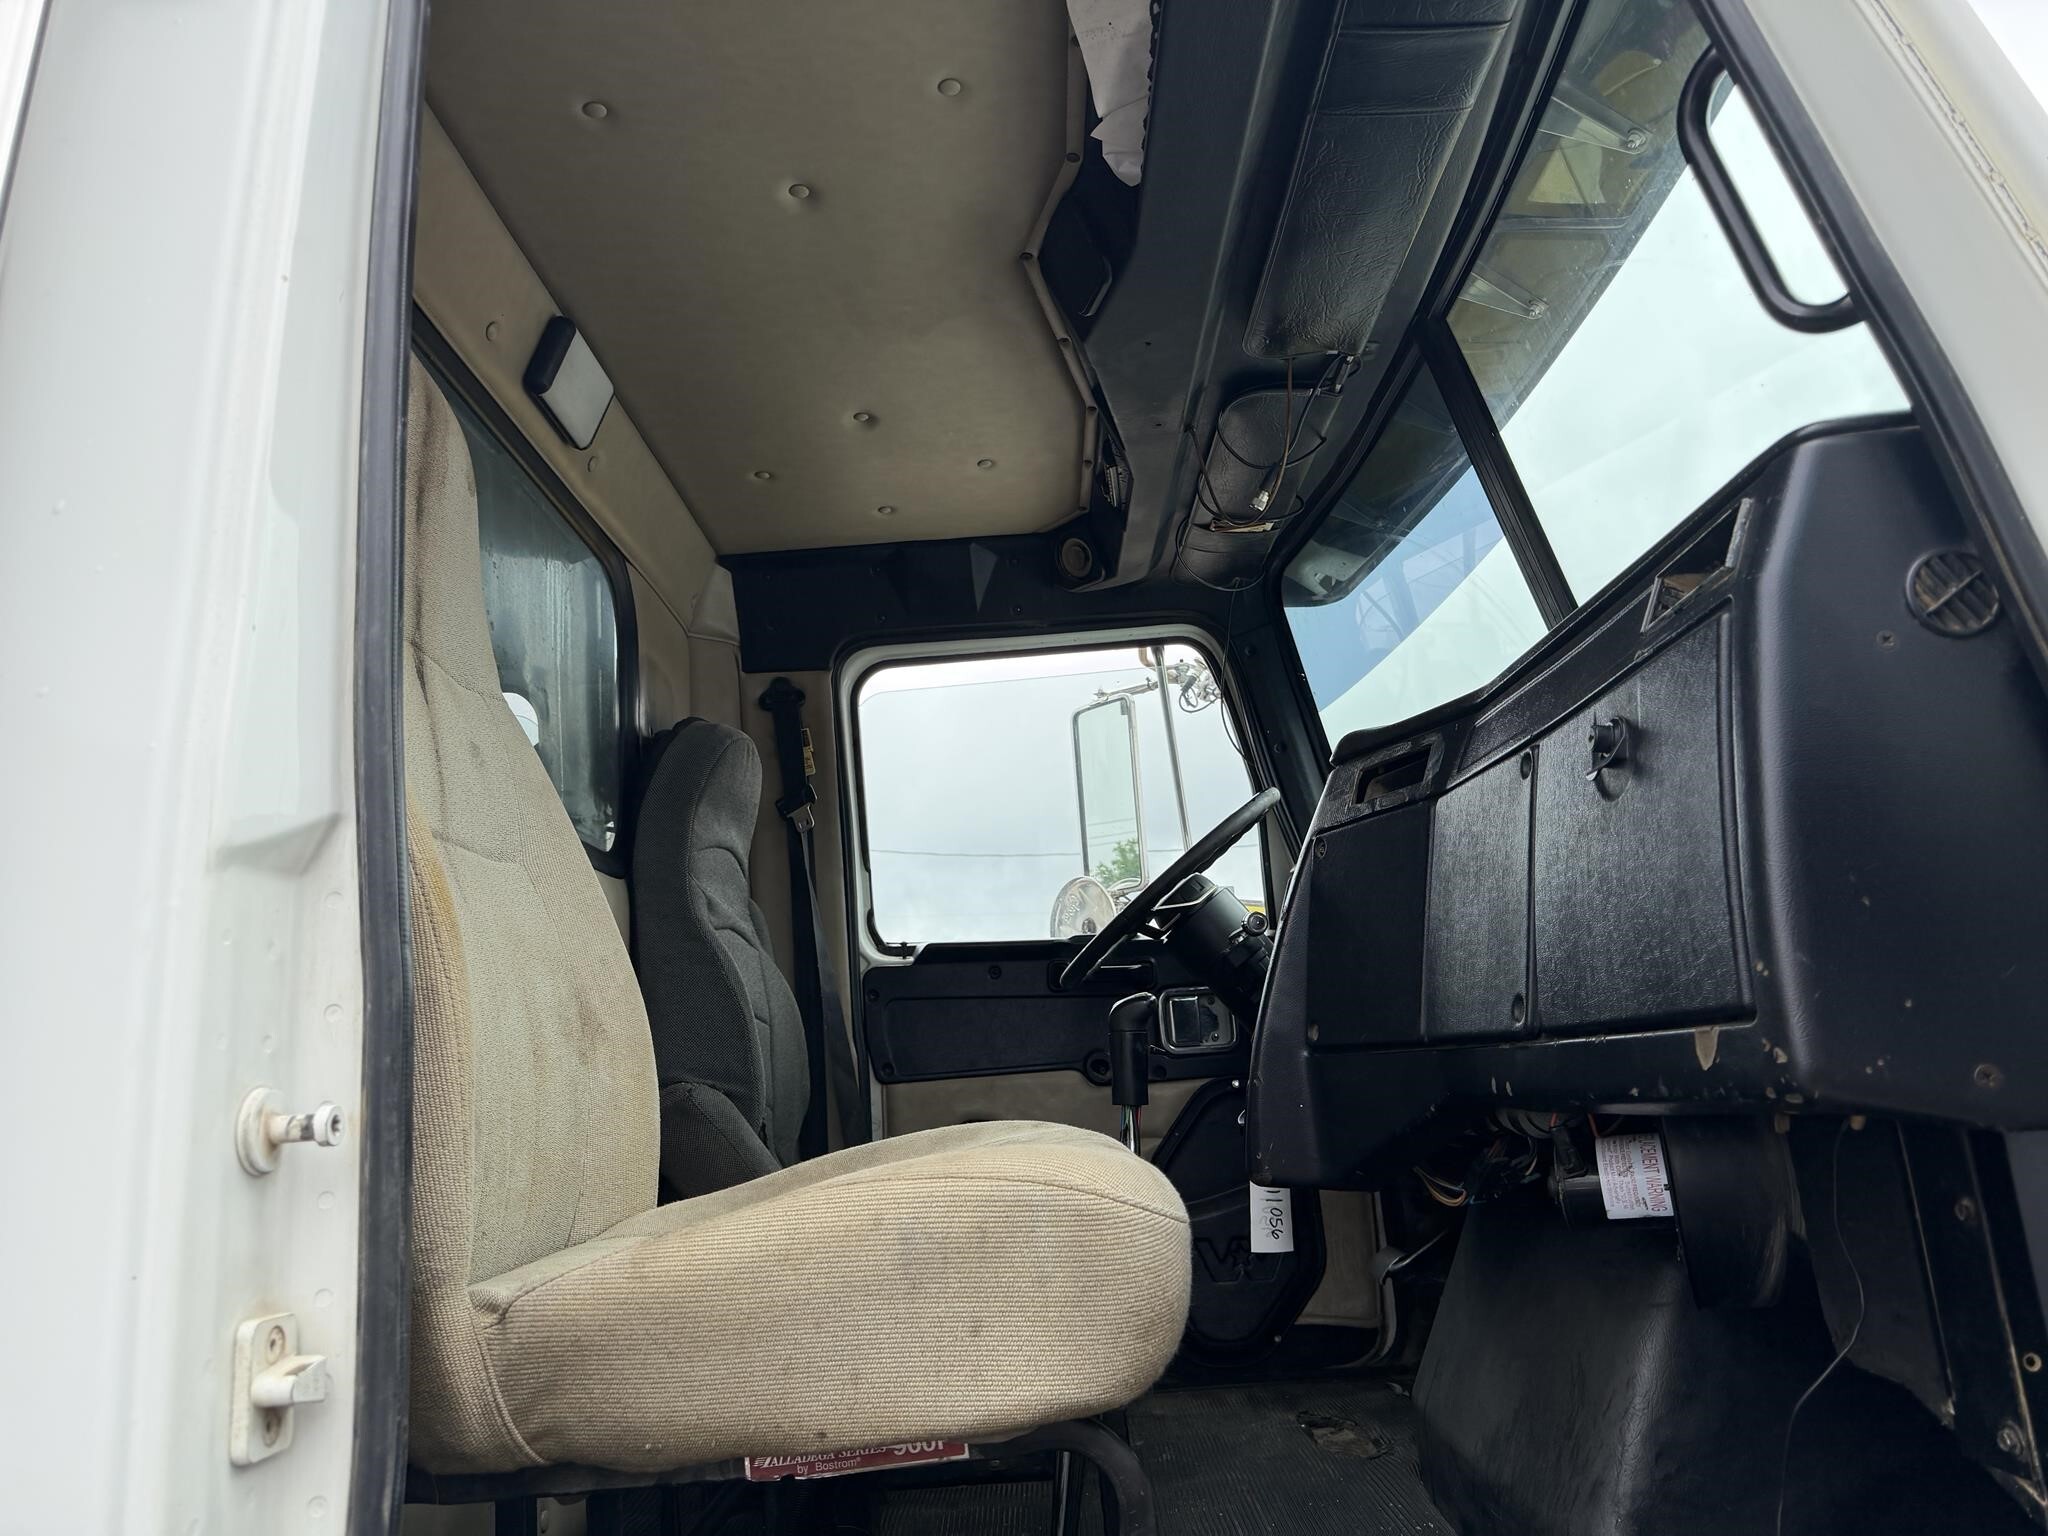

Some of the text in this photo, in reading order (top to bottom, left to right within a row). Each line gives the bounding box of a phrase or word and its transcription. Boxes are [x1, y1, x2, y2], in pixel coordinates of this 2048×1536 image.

[1646, 1176, 1667, 1212] WARNING
[1265, 1190, 1284, 1240] 11056
[797, 1464, 808, 1475] by
